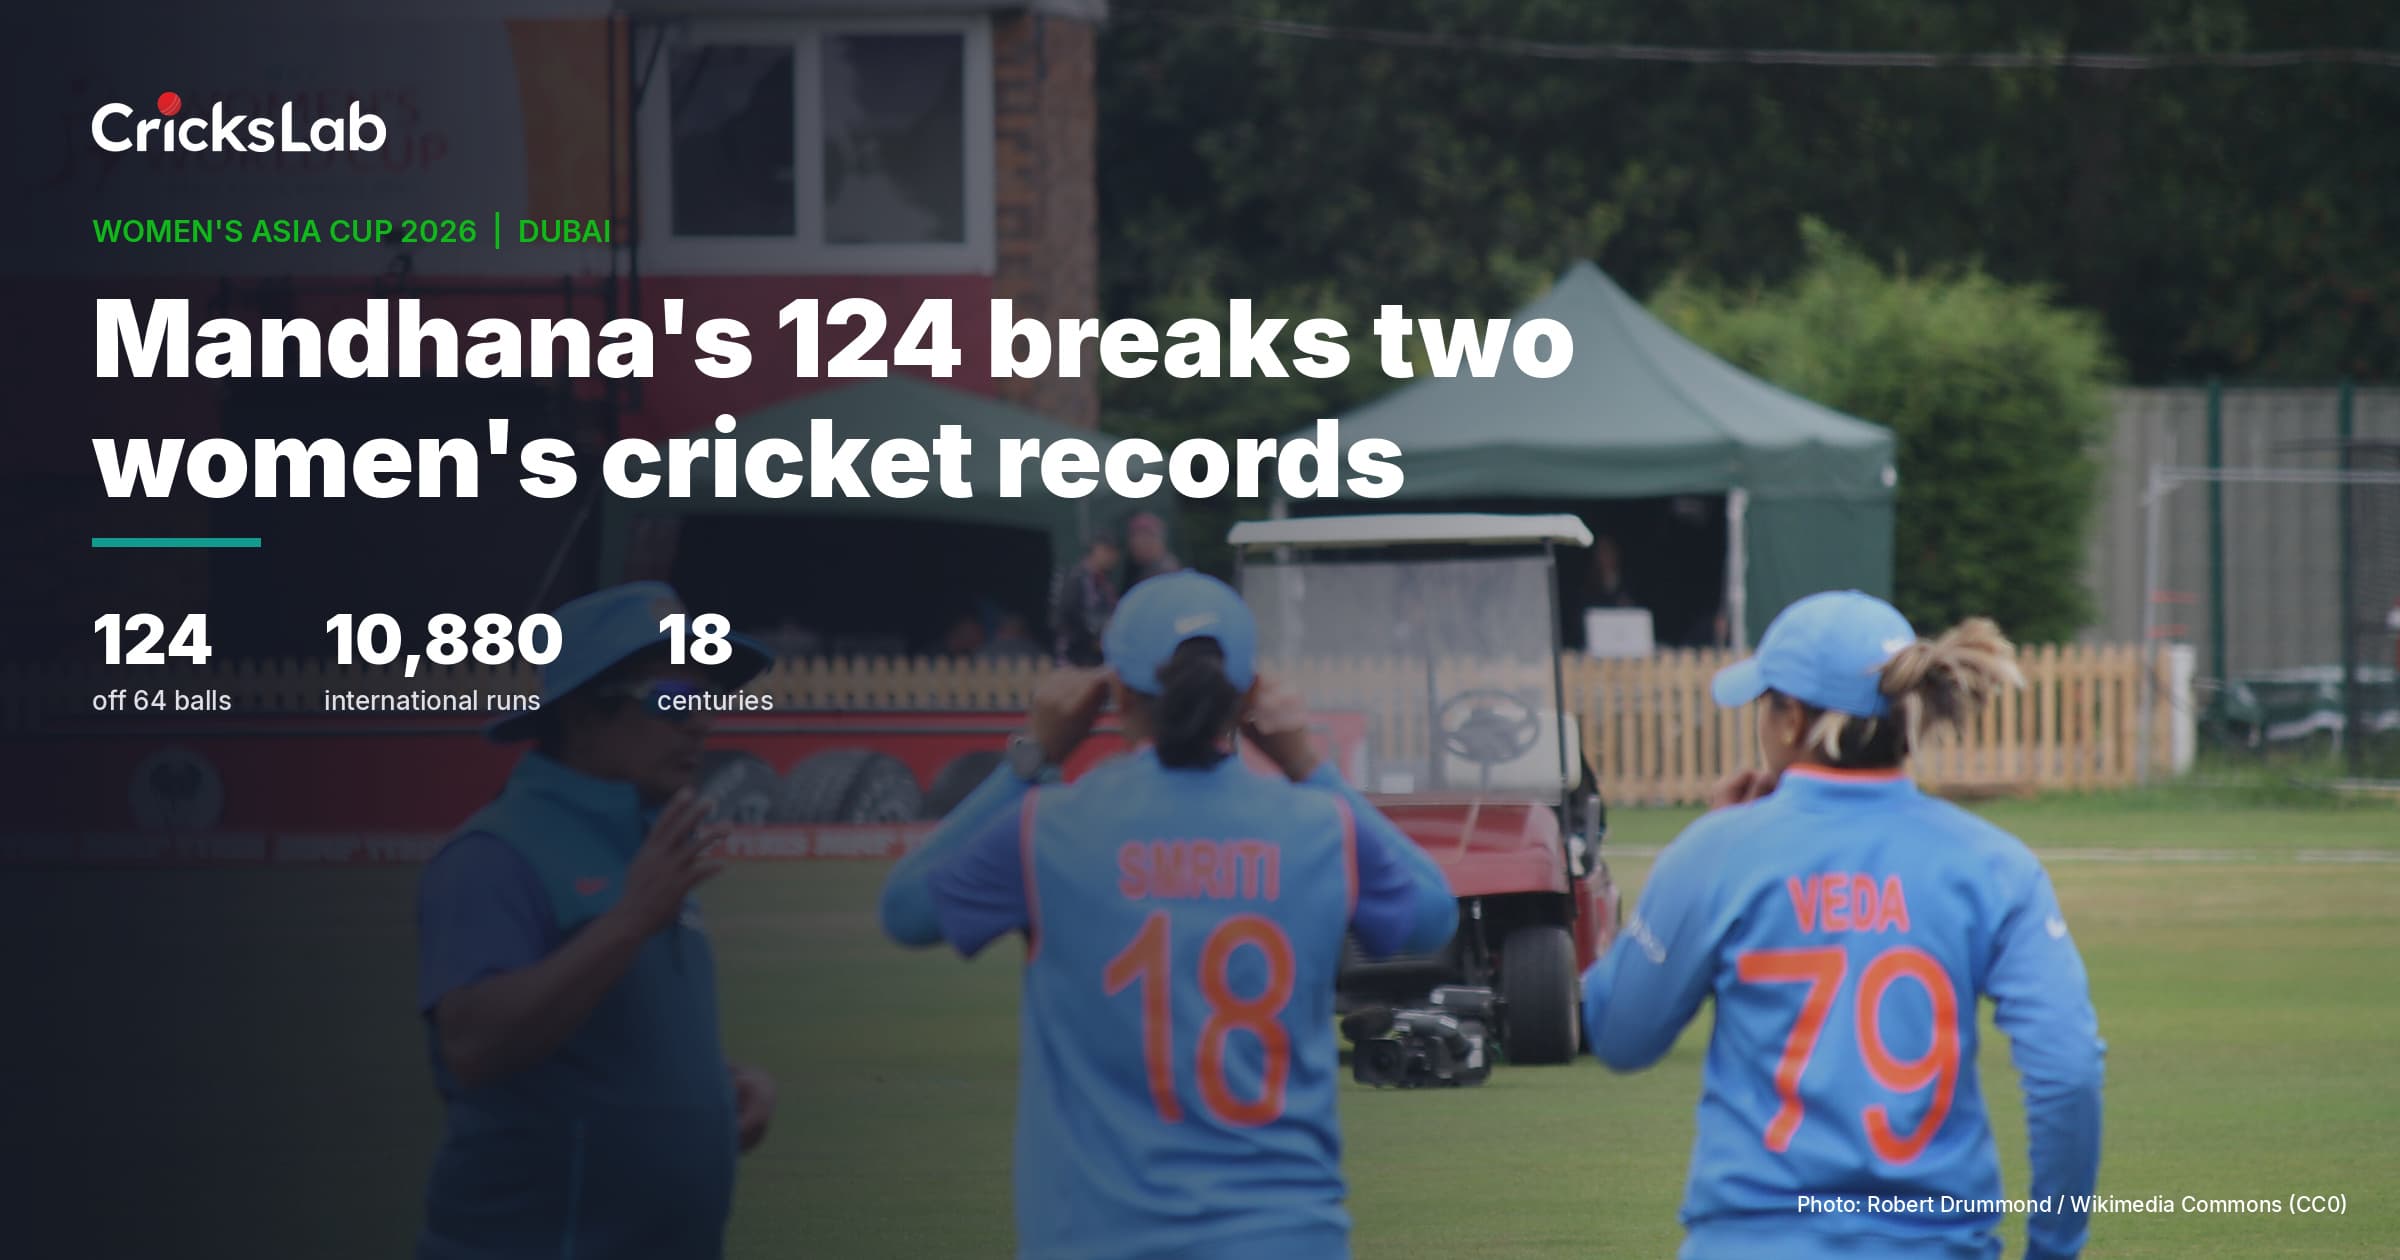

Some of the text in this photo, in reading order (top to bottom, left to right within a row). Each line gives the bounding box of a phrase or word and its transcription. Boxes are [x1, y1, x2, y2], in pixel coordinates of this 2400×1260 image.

[1119, 839, 1280, 900] SMRITI
[1787, 874, 1910, 933] VEDA
[1104, 911, 1296, 1126] 18
[1737, 946, 1960, 1164] 79
